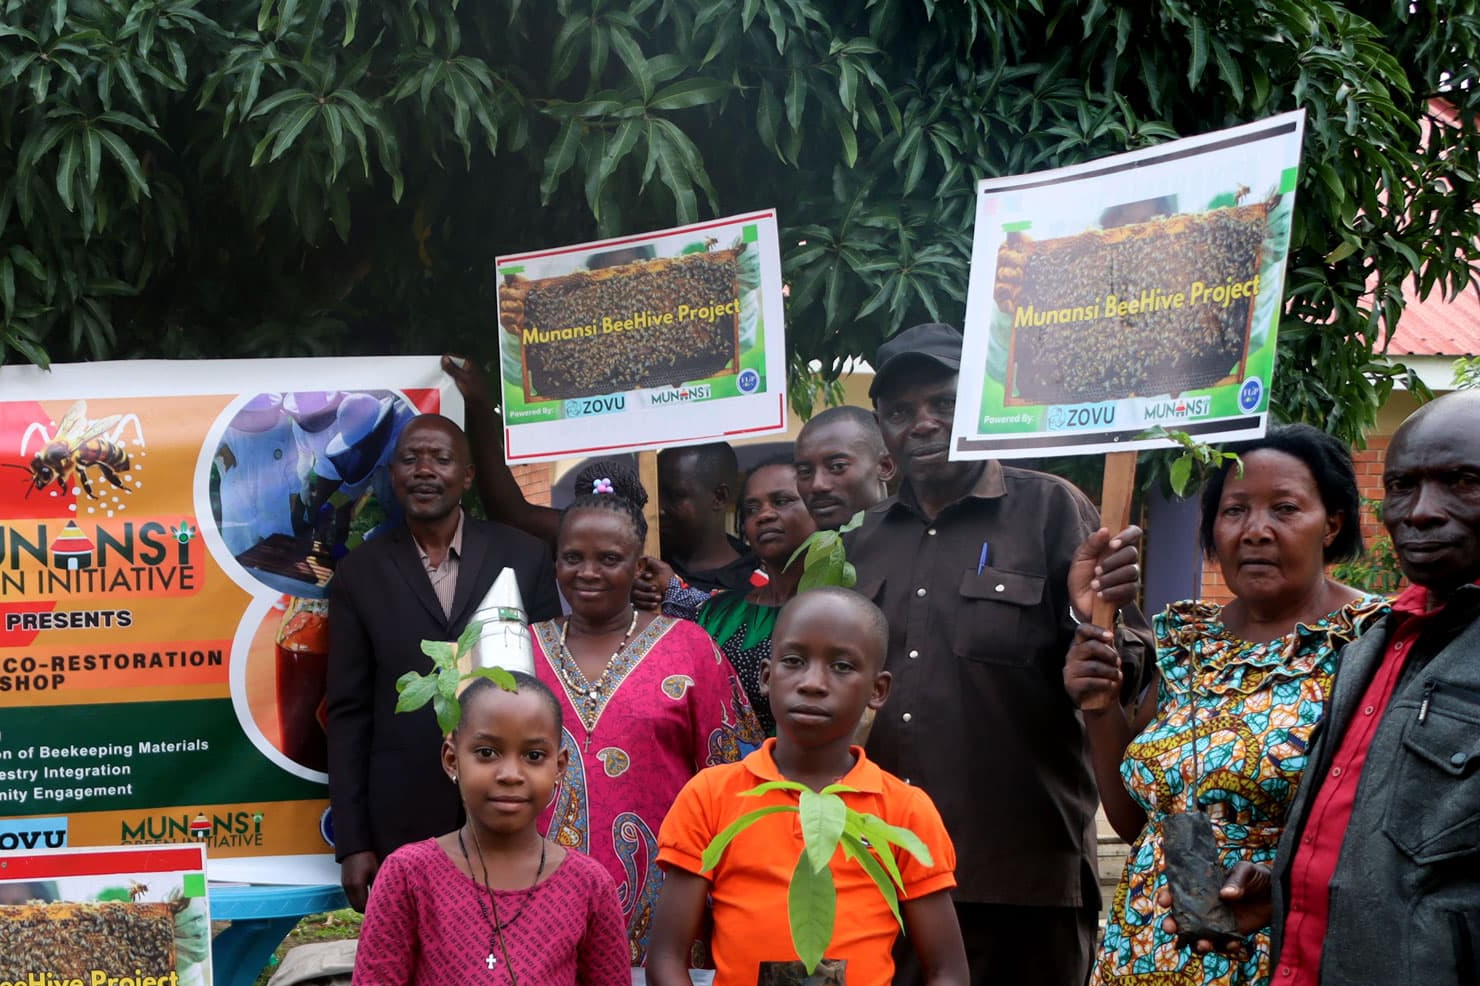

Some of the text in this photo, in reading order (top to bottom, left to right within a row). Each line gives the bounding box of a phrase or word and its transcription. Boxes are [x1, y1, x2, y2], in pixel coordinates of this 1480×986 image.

[1014, 275, 1261, 329] Munansi BeeHive Project
[522, 299, 742, 345] Munansi BeeHive Project
[583, 398, 625, 414] ZOVU
[1067, 406, 1115, 427] ZOVU
[38, 566, 194, 594] INITIATIVE
[6, 610, 132, 631] PRESENTS
[18, 747, 34, 759] of
[40, 745, 132, 758] Beekeeping
[139, 739, 208, 754] Materials
[44, 764, 131, 779] Integration
[34, 784, 132, 800] Engagement
